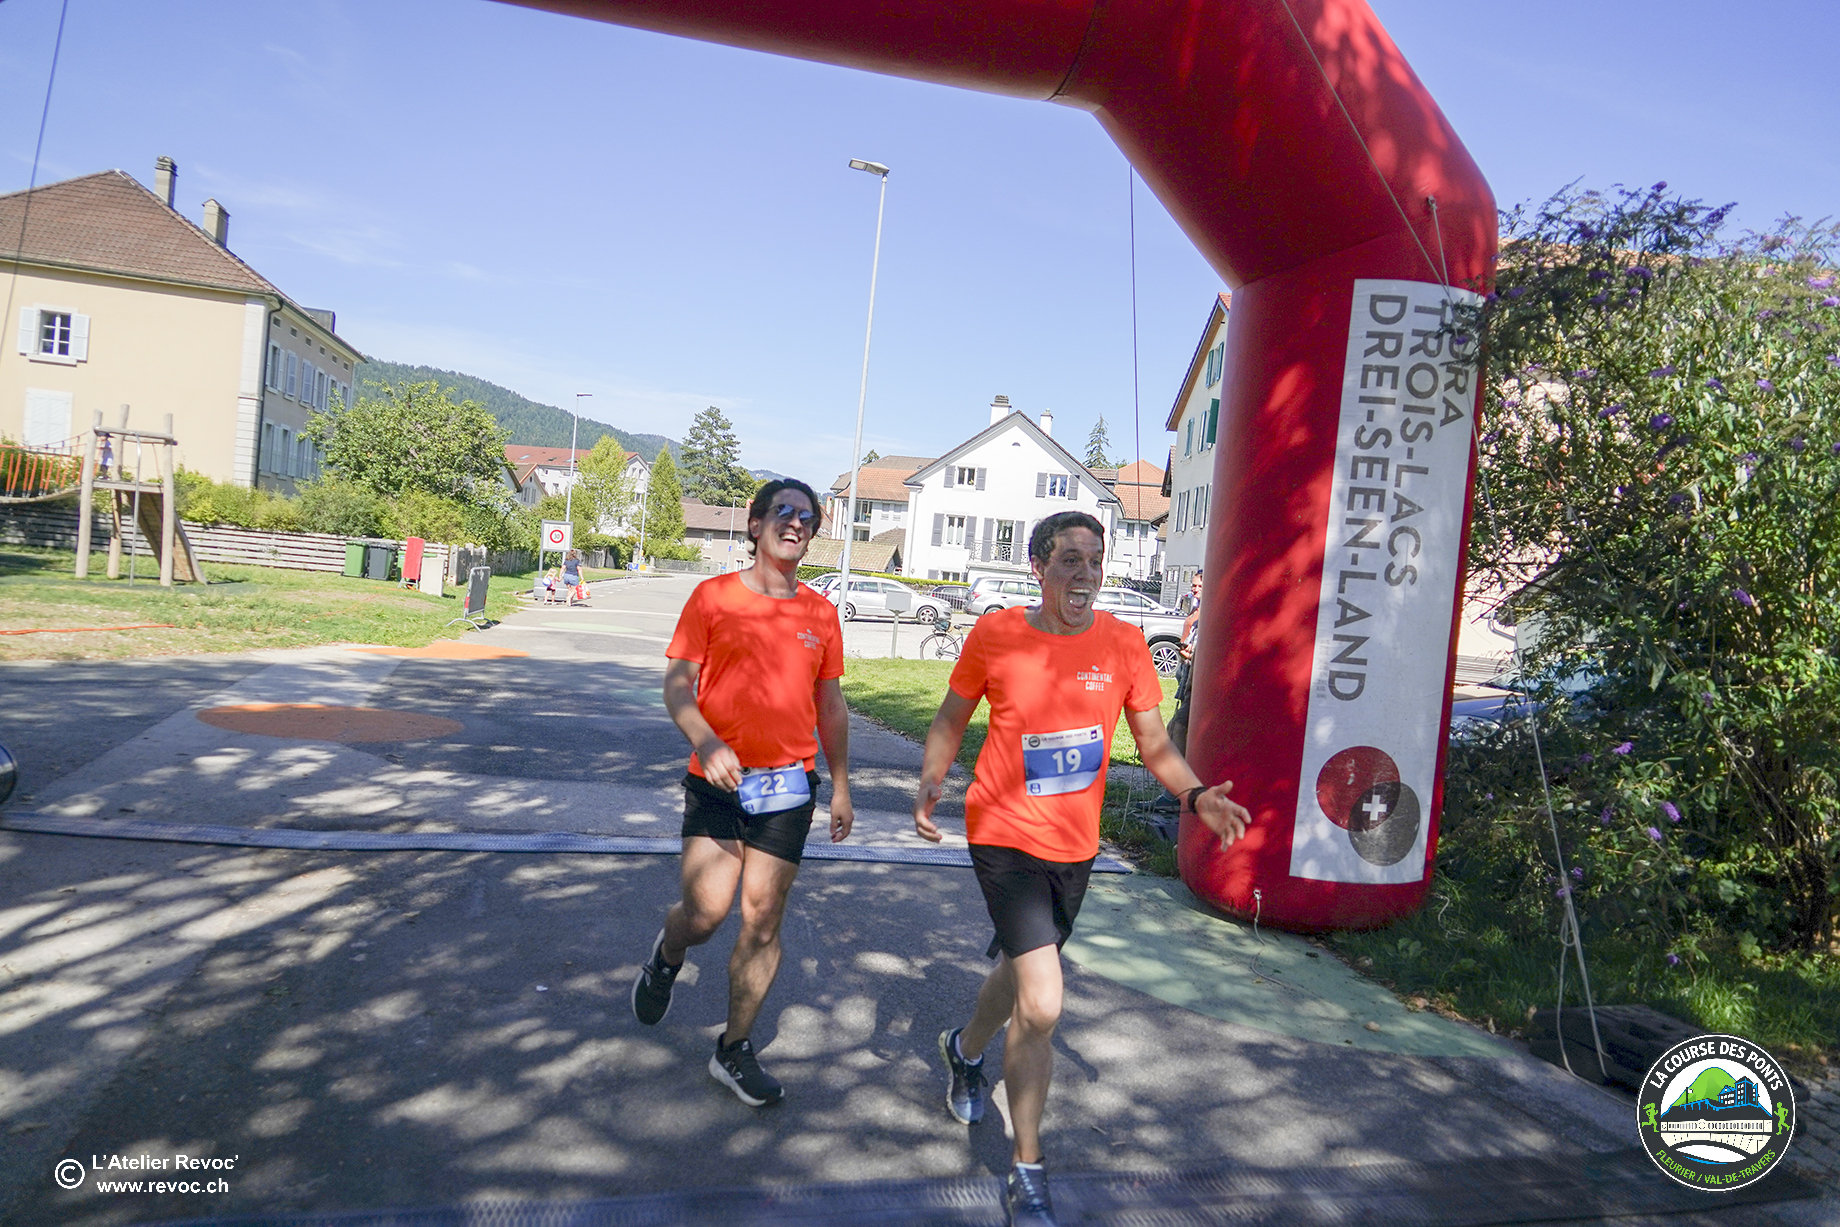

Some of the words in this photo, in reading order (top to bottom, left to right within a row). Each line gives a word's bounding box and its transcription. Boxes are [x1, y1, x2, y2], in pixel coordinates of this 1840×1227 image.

[1384, 299, 1447, 587] TROIS-LACS
[1328, 294, 1408, 701] DREI-SEEN-LAND
[1077, 671, 1113, 683] CONTINENTAL
[1085, 681, 1104, 691] COFFEE
[1051, 748, 1081, 774] 19
[760, 774, 788, 796] 22
